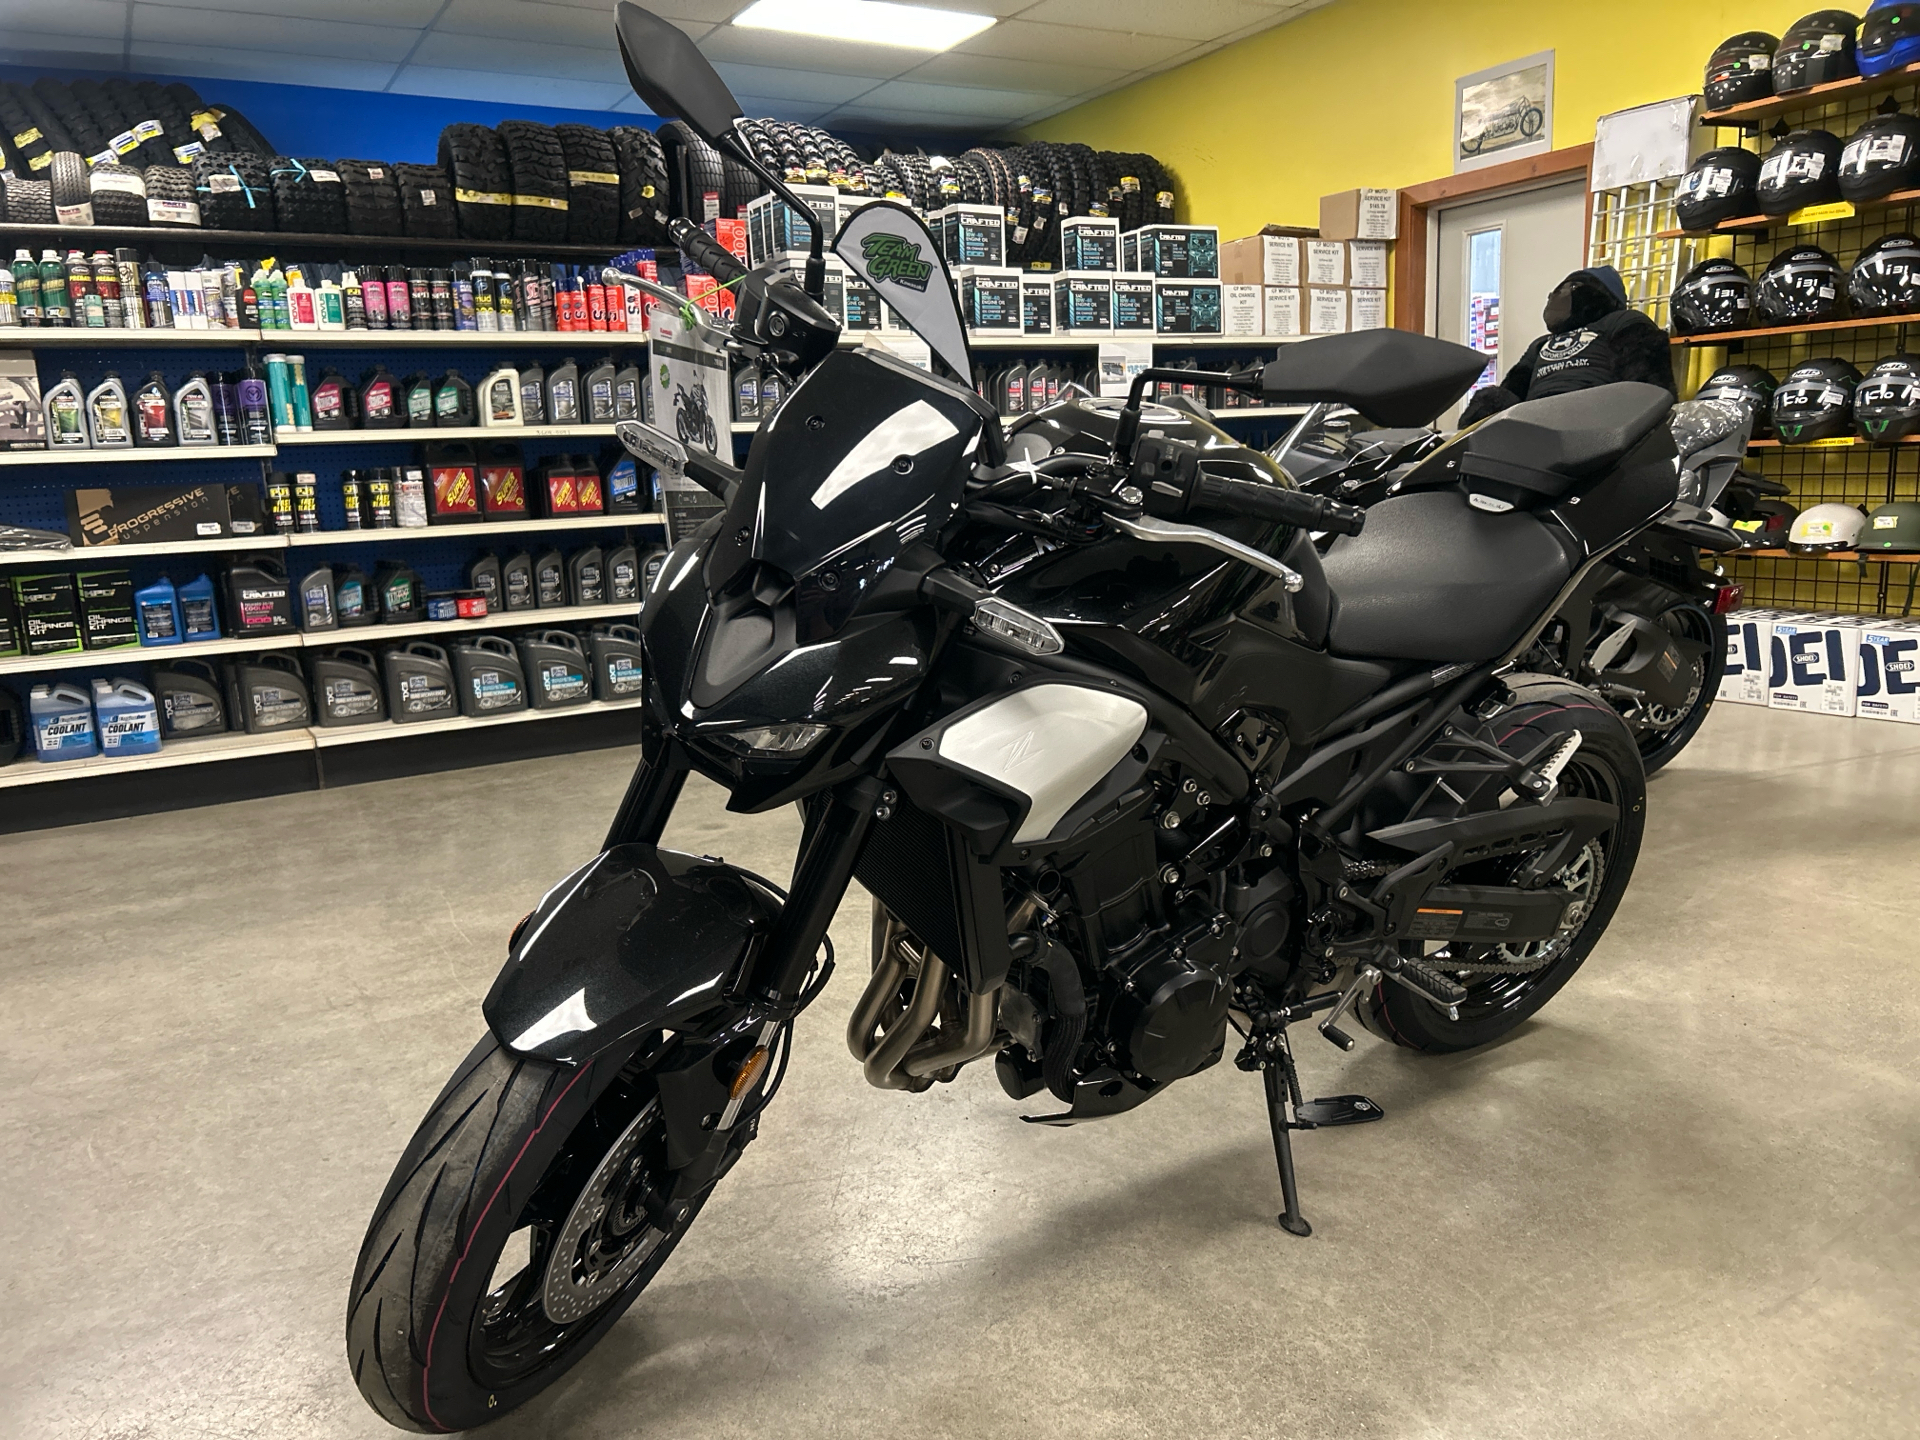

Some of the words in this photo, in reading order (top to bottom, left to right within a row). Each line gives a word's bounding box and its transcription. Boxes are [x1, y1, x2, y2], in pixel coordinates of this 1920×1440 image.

[960, 217, 1001, 227] CRAFTED
[1078, 229, 1115, 237] CRAFTED
[1159, 233, 1186, 241] CRAFTED
[863, 234, 918, 262] TEAM
[868, 255, 931, 279] GREEN
[976, 281, 1019, 289] CRAFTED
[1070, 284, 1109, 292] CRAFTED
[1023, 288, 1050, 296] AFTED
[1877, 362, 1909, 372] HJC
[1793, 369, 1823, 378] HJC
[1711, 375, 1739, 384] HJC
[446, 471, 468, 508] SUPER
[496, 471, 515, 506] SUPER
[107, 487, 205, 538] PROGRESSIVE
[243, 590, 286, 599] CRAFTED
[89, 616, 132, 625] CHANGE
[29, 622, 74, 631] CHANGE
[1796, 654, 1815, 662] SHOEI
[1888, 663, 1913, 671] SHOEI
[609, 664, 617, 684] EXP
[543, 670, 551, 691] EXP
[401, 681, 409, 702] EXL
[473, 678, 482, 699] EXP
[326, 686, 335, 706] EXL
[165, 699, 174, 720] EXL
[254, 694, 263, 715] EXL
[48, 722, 87, 736] COOLANT
[108, 722, 146, 734] COOLANT
